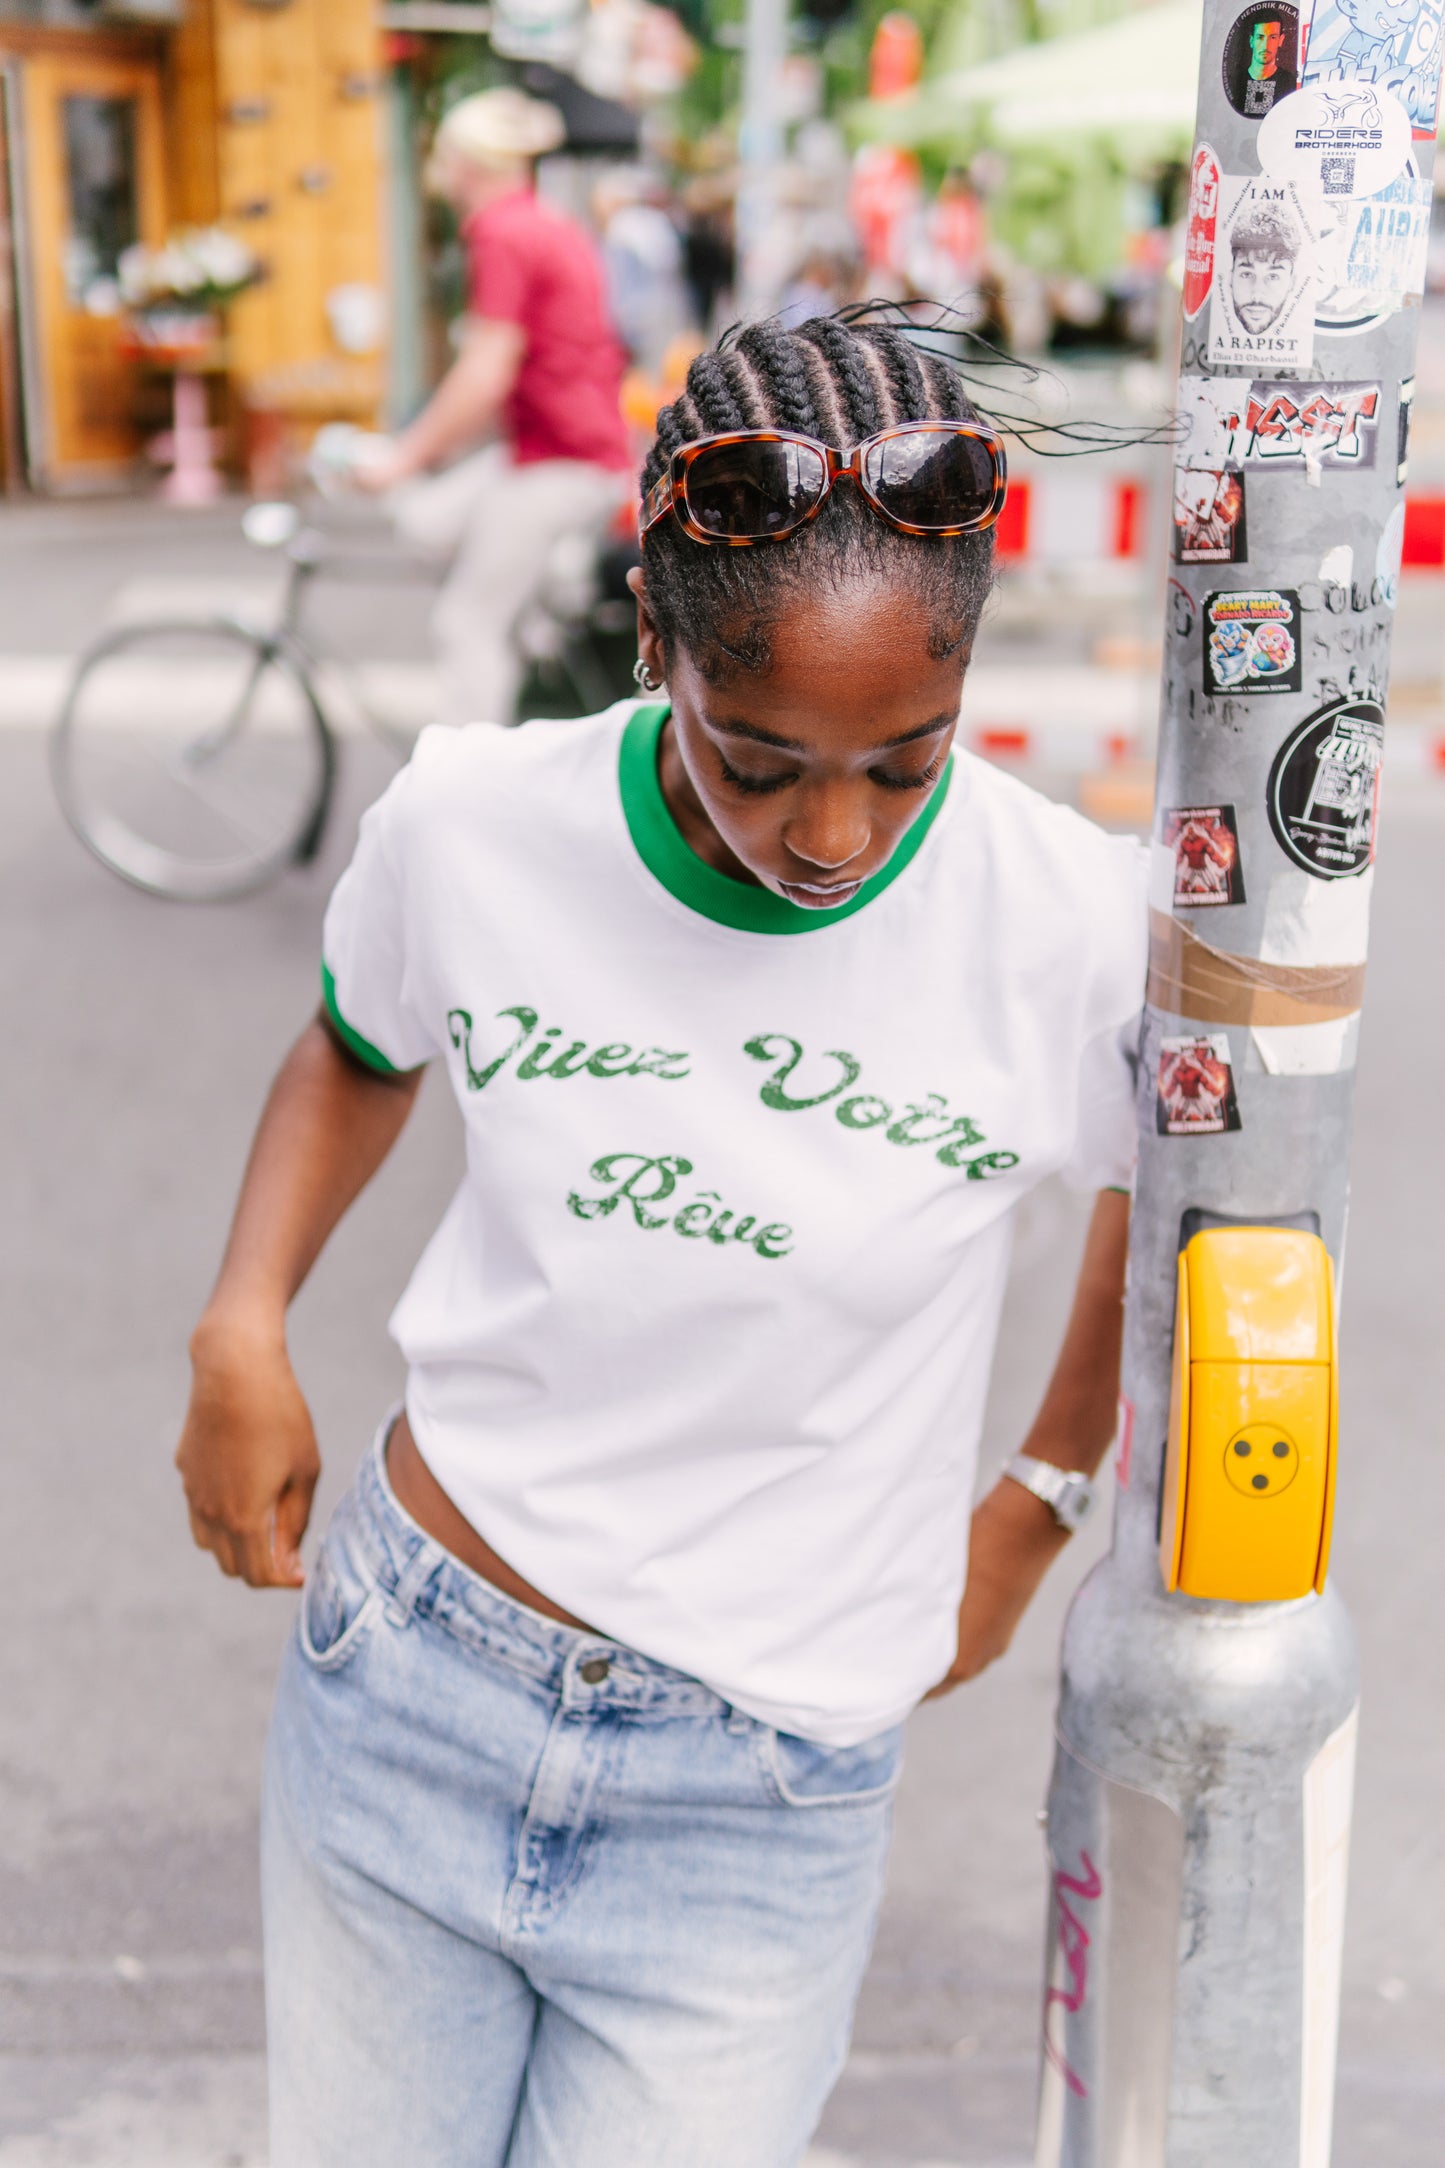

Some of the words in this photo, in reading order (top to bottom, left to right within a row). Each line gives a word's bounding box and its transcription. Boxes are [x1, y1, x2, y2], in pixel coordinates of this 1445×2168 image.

[1240, 2, 1276, 21] HENDRIK
[1295, 129, 1383, 139] RIDERS
[1294, 141, 1383, 149] BROTHERHOOD
[1251, 188, 1257, 200] I
[1260, 188, 1286, 201] AM
[1214, 336, 1225, 349] A
[1230, 336, 1299, 352] RAPIST
[450, 1006, 690, 1091] Vivez
[566, 1153, 794, 1259] Rêve
